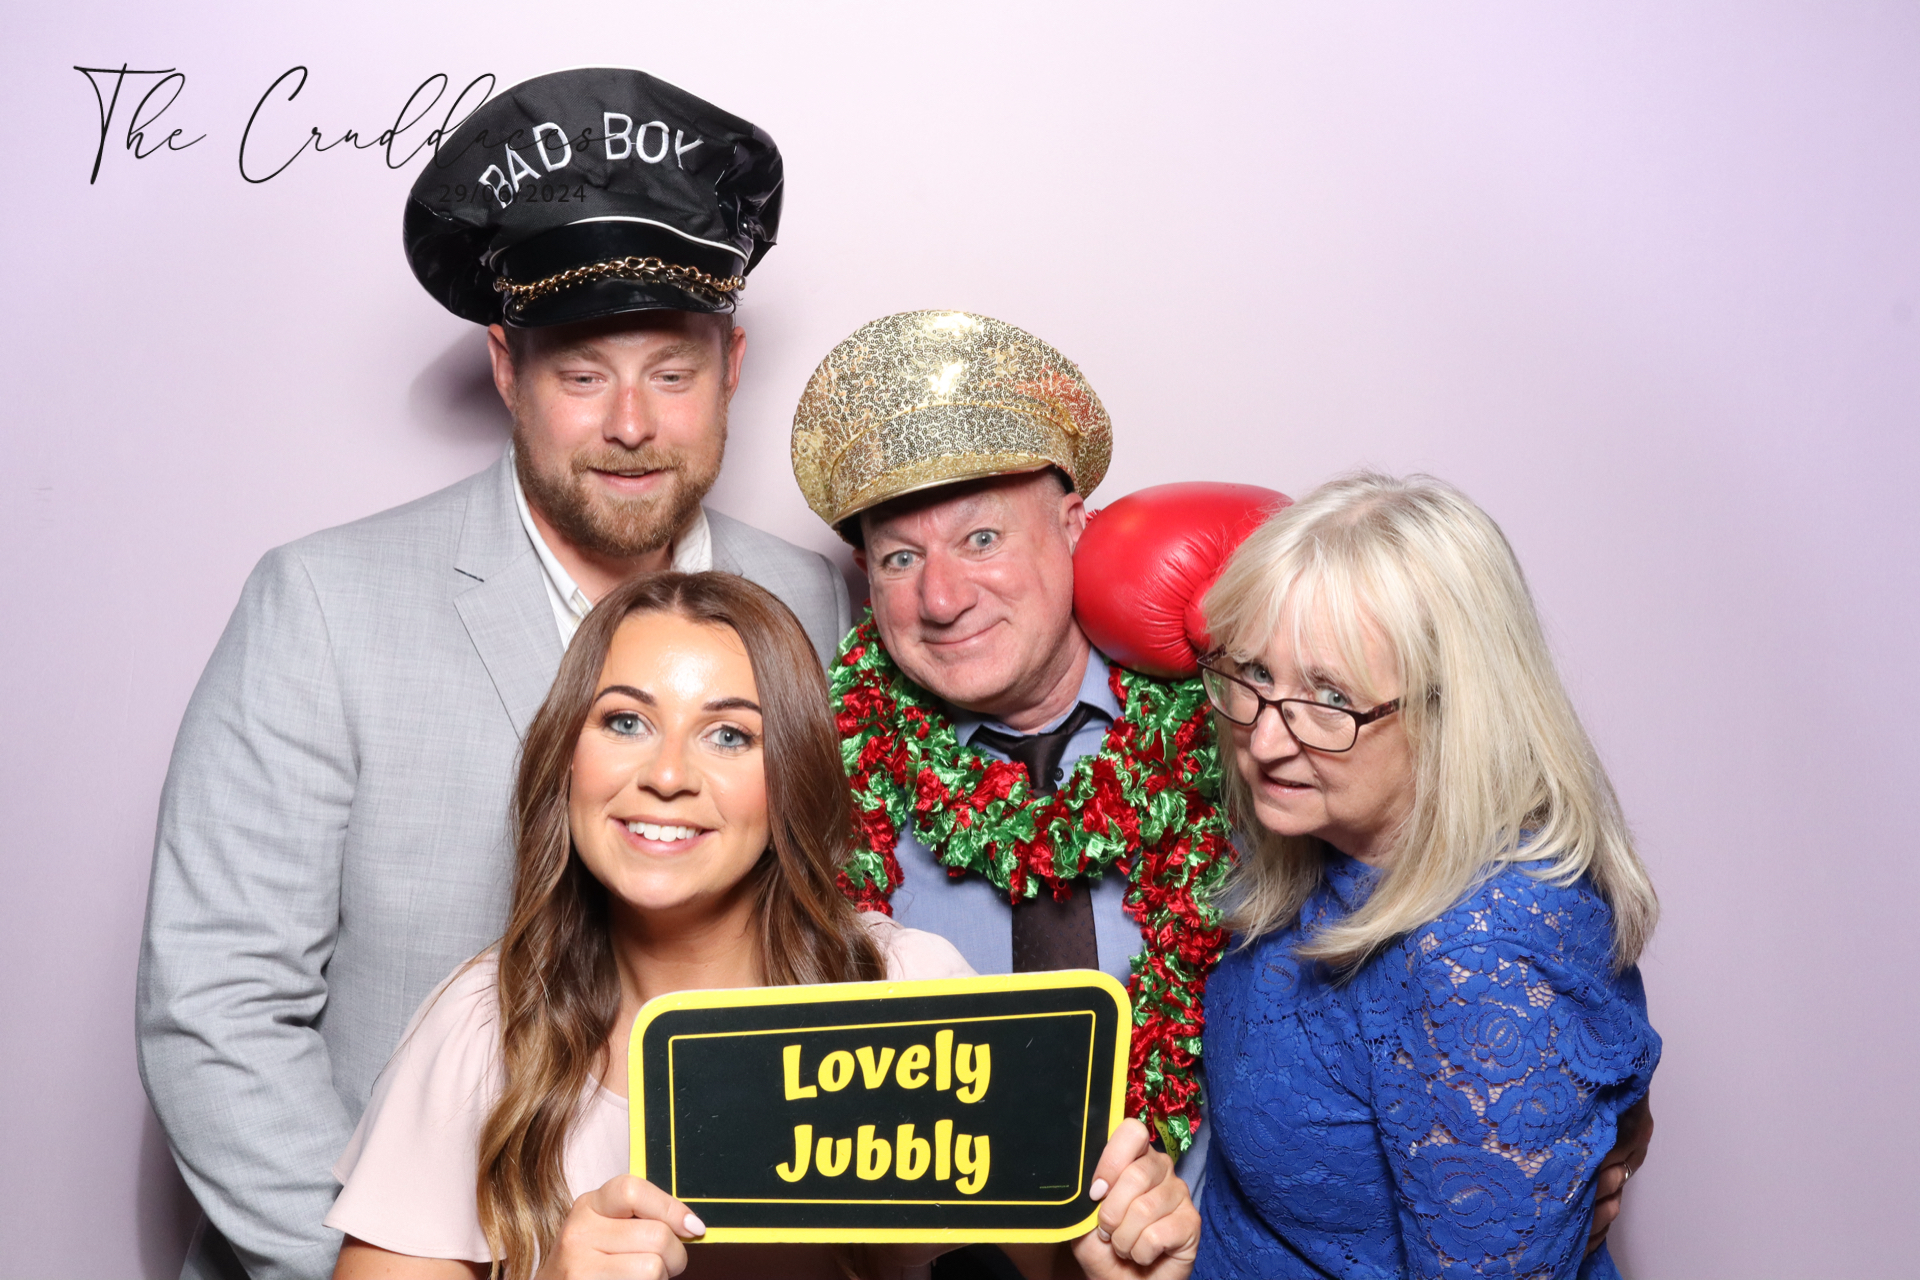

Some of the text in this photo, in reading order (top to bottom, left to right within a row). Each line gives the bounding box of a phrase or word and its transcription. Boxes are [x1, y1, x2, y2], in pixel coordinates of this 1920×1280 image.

[478, 112, 704, 209] BAD BOY
[783, 1029, 991, 1103] Lovely
[776, 1119, 990, 1195] Jubbly
